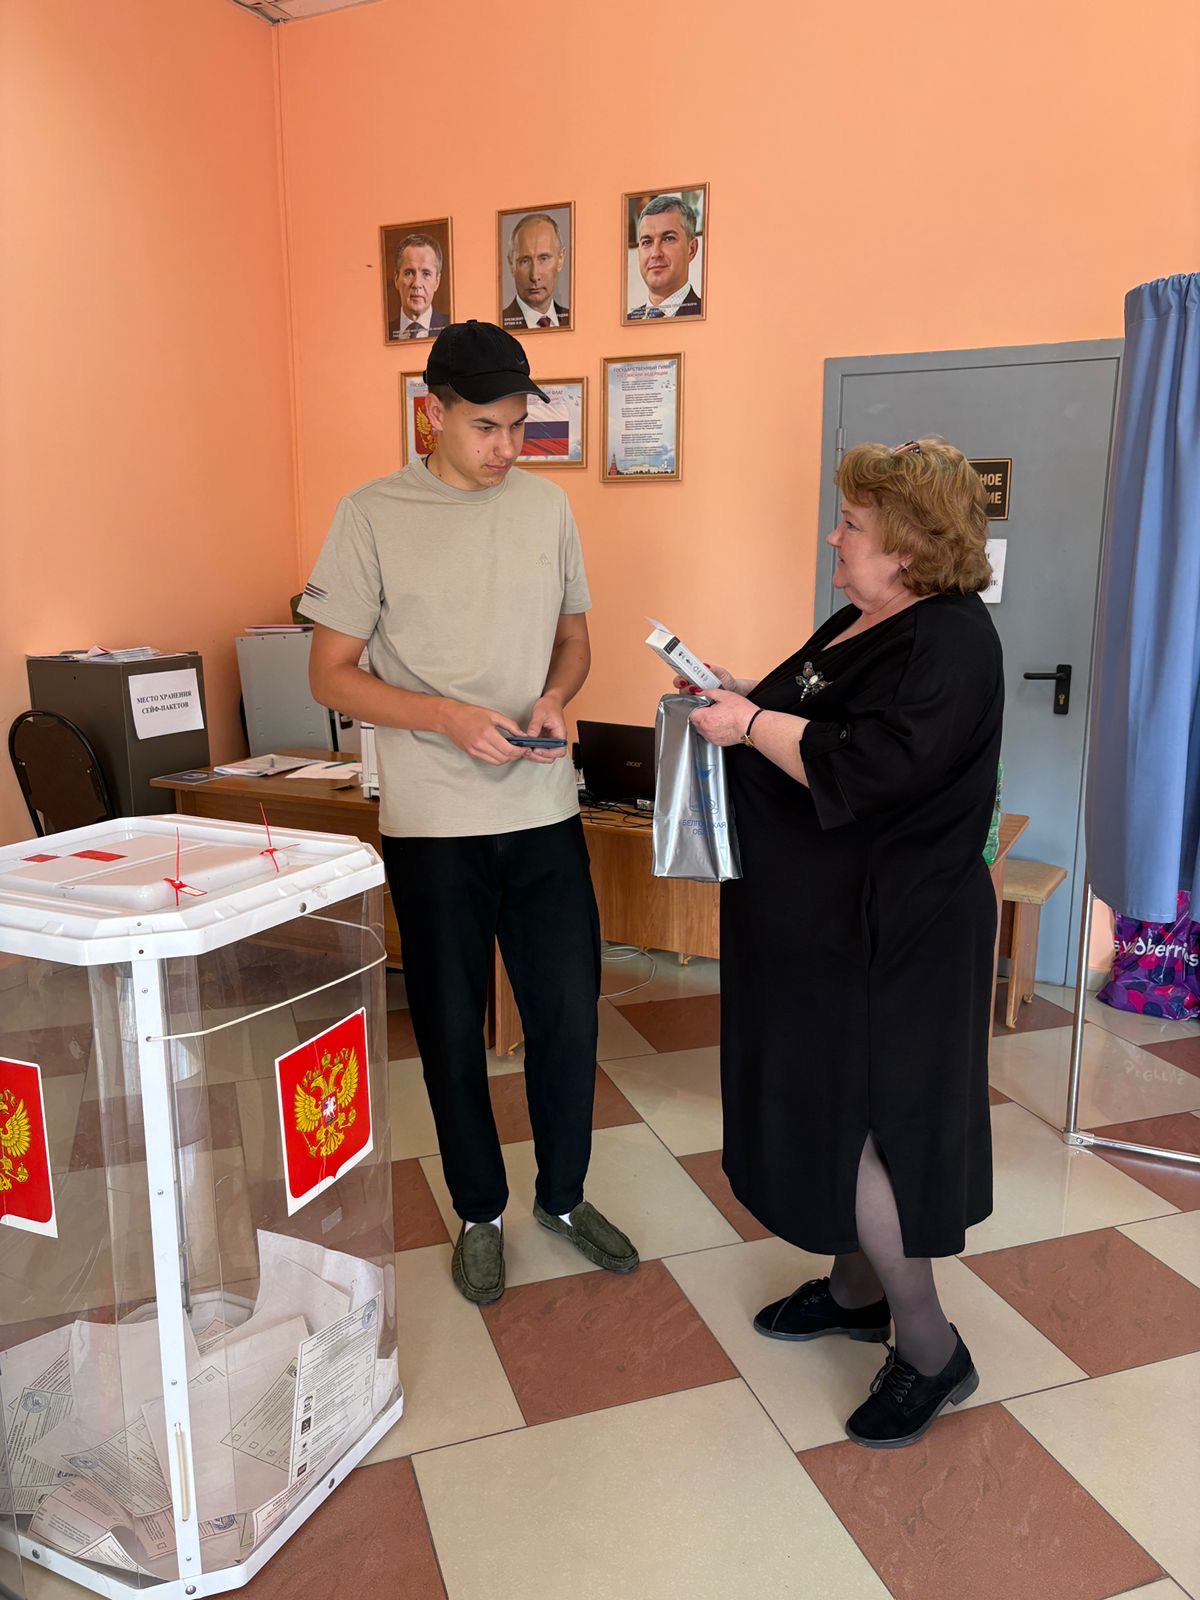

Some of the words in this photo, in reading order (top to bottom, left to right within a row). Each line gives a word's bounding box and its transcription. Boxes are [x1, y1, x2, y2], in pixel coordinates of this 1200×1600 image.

[979, 473, 1003, 486] НОЕ
[137, 695, 158, 703] МЕСТО
[160, 691, 191, 700] ХРАНЕНИЯ
[142, 702, 189, 714] СЕЙФ-ПАКЕТОВ
